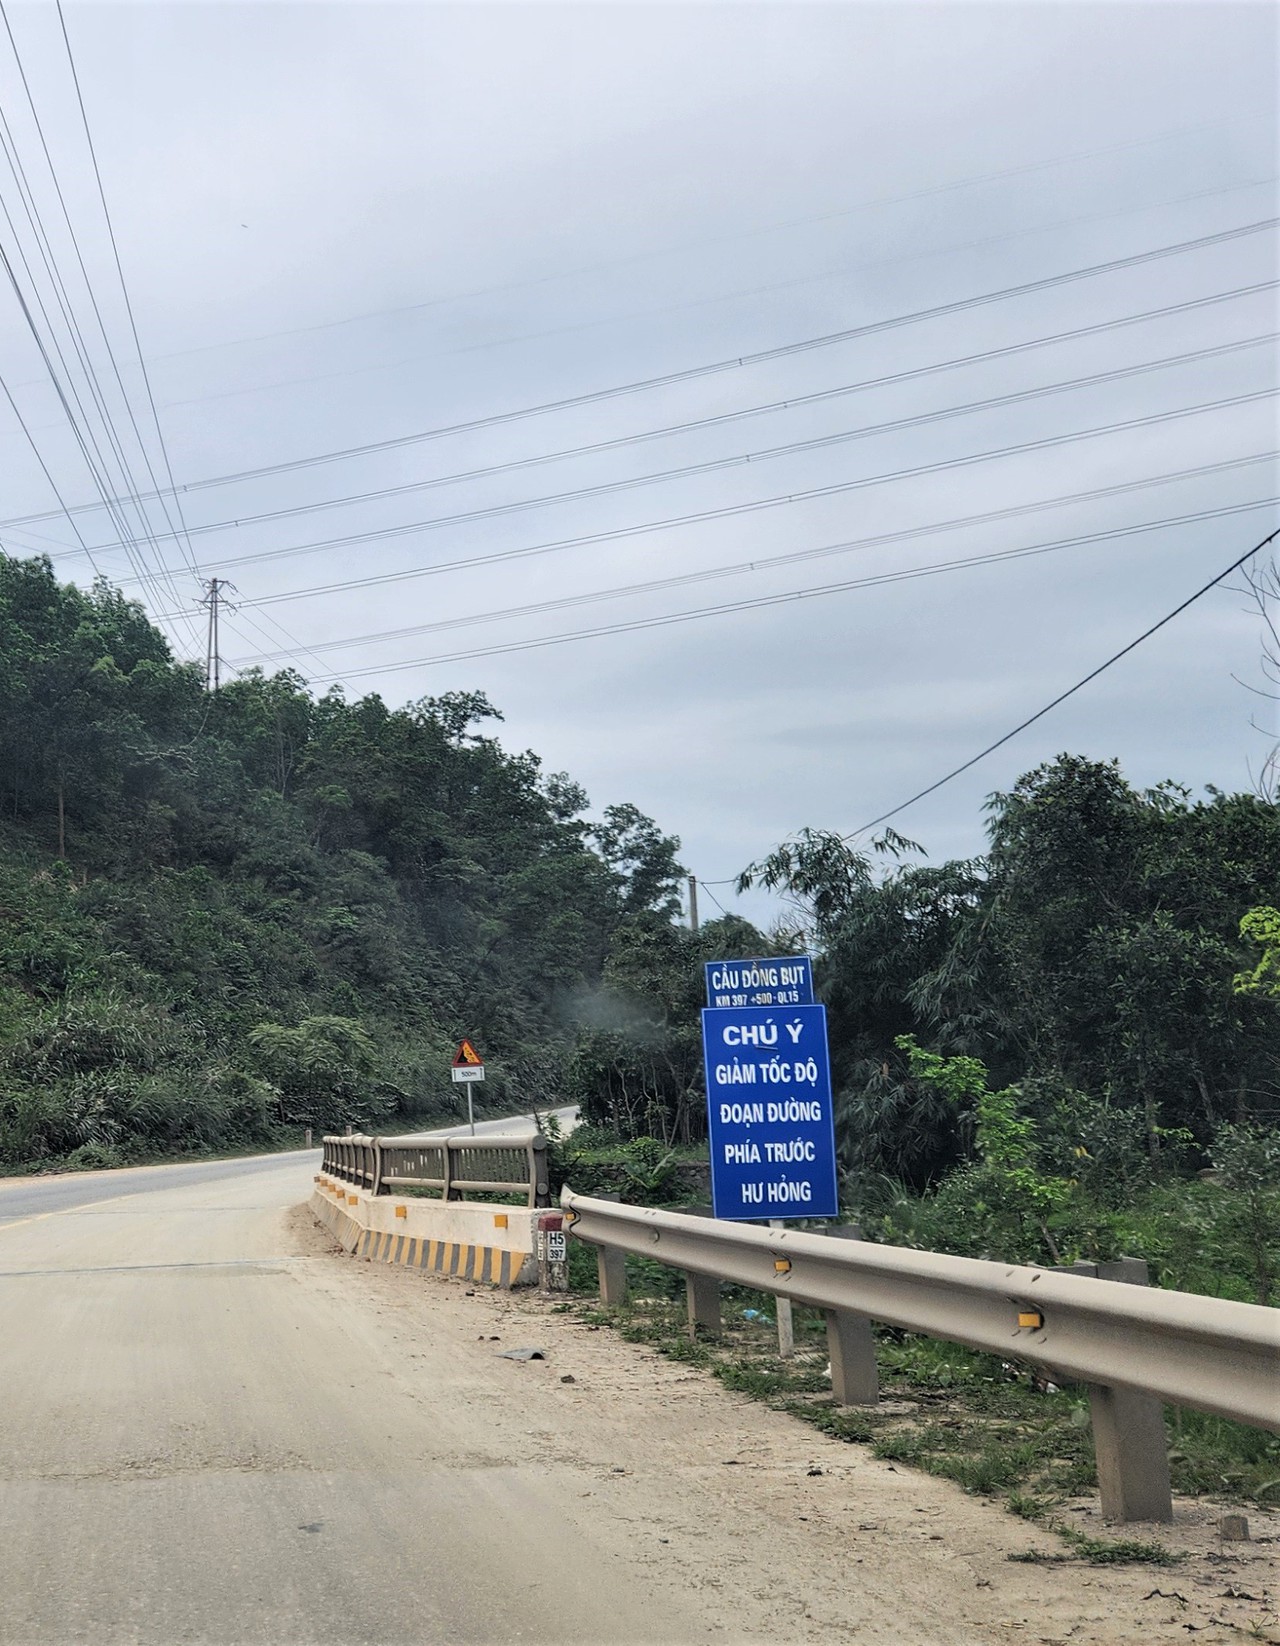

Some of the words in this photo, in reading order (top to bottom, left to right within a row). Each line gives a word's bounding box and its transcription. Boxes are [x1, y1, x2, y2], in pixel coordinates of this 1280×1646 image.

[712, 964, 739, 990] CẦU
[780, 966, 805, 989] BỤT
[715, 995, 730, 1007] KM
[731, 994, 748, 1006] 397
[722, 1019, 778, 1046] CHÚ
[786, 1018, 804, 1044] Ý
[716, 1057, 756, 1085] GIẢM
[760, 1055, 791, 1084] TỐC
[794, 1057, 818, 1088] ĐỘ
[720, 1103, 764, 1128] ĐOẠN
[767, 1097, 821, 1123] ĐƯỜNG
[725, 1139, 761, 1165] PHÍA
[764, 1137, 816, 1163] TRƯỚC
[742, 1182, 763, 1204] HƯ
[767, 1174, 812, 1203] HỎNG
[550, 1233, 564, 1245] H5
[550, 1249, 564, 1259] 397
